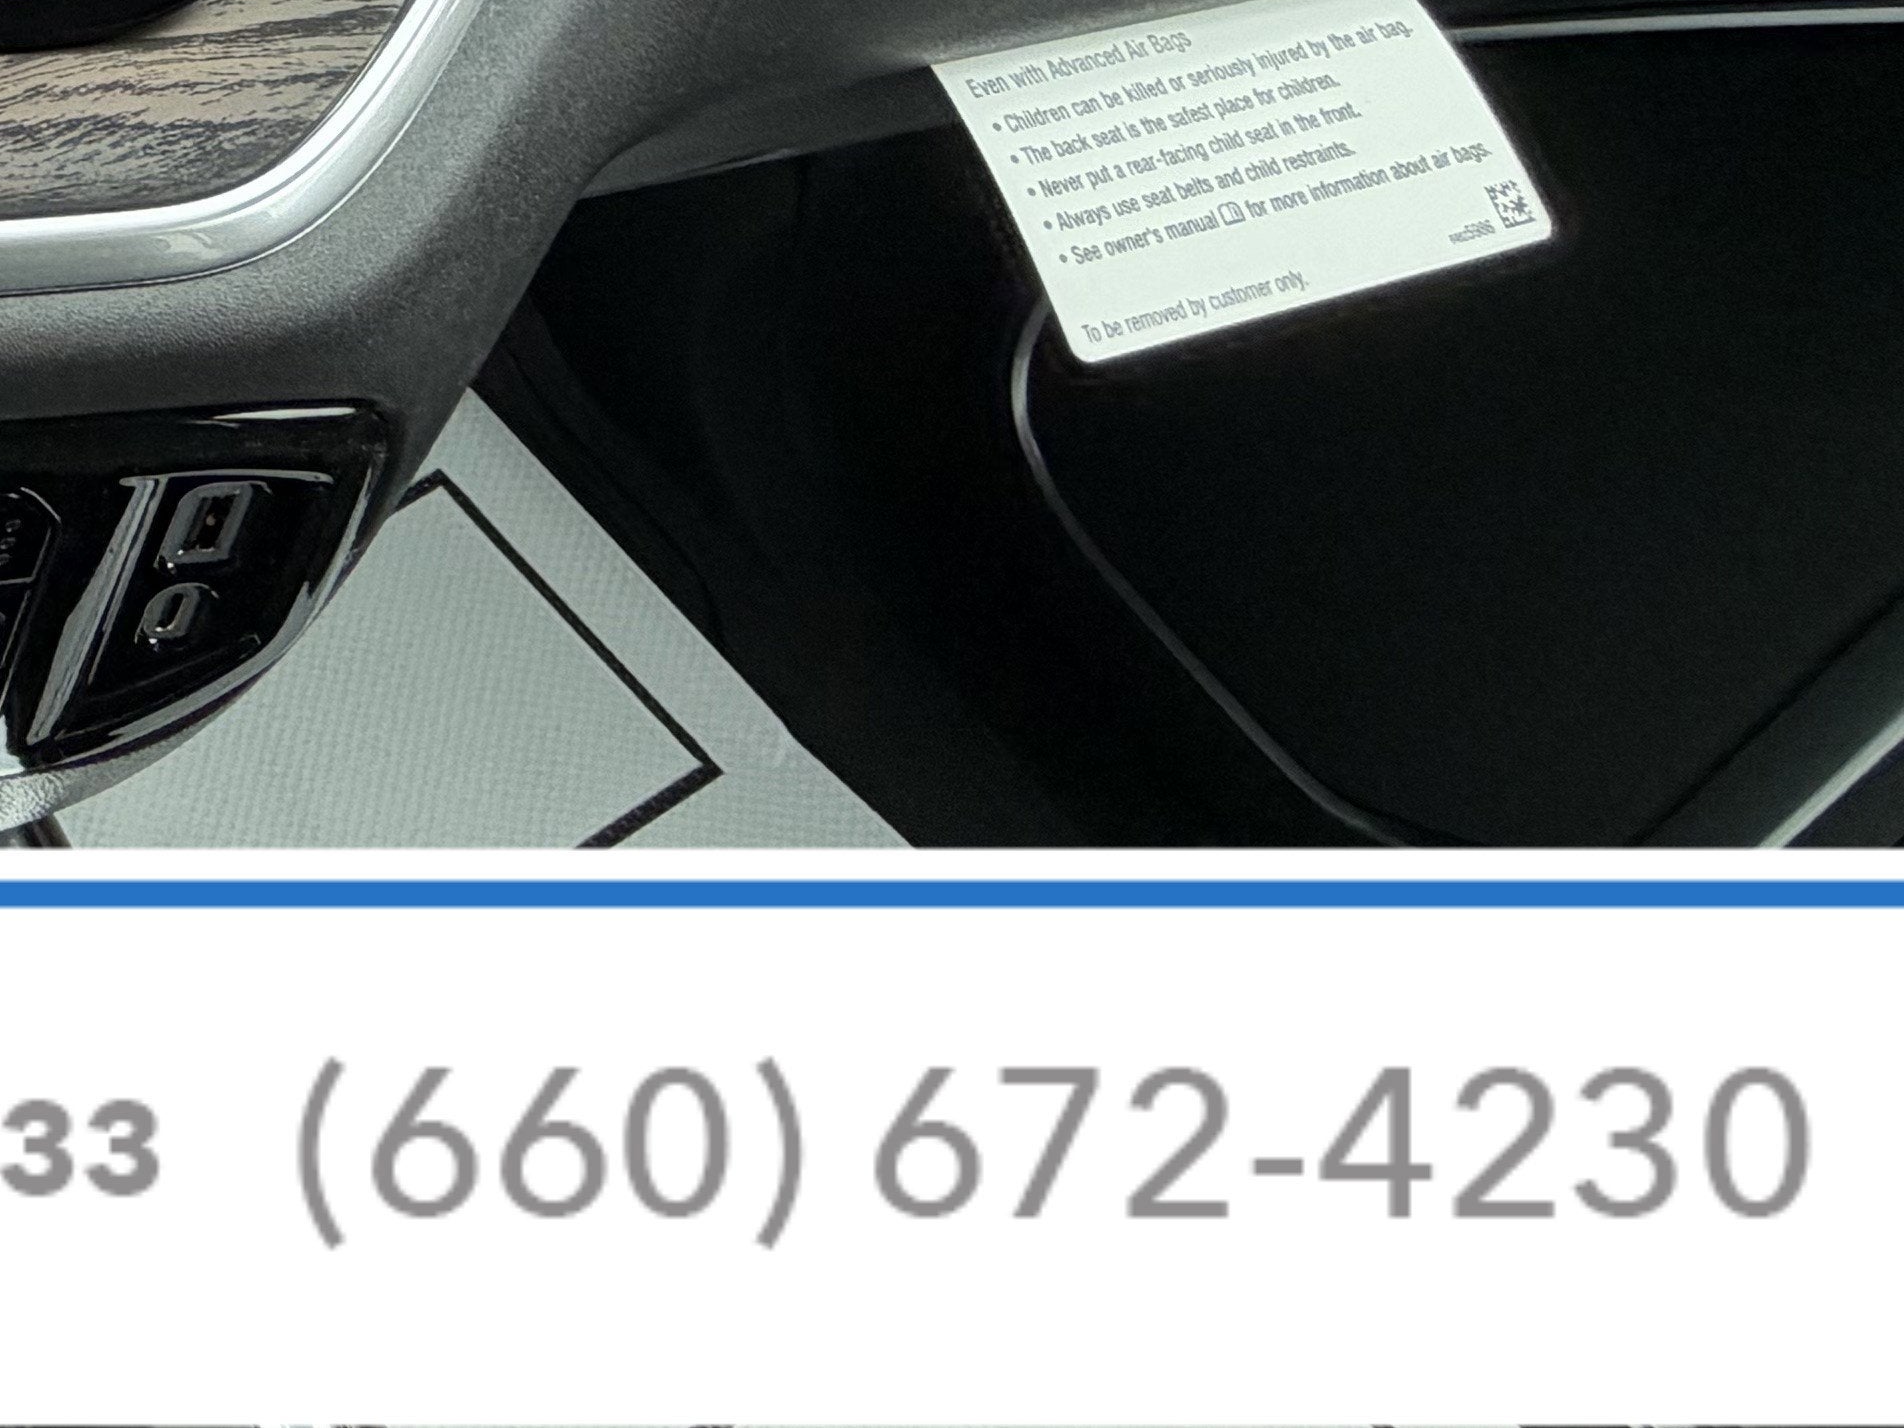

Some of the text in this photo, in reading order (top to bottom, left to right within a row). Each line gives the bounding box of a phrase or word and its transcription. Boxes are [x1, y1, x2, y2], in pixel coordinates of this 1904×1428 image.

[965, 32, 1192, 98] Even with Advanced Air Bags
[1004, 20, 1413, 133] Children can be killed or seriously injured by the air bag.
[1019, 73, 1341, 166] The back seat is the safest place for children.
[1038, 102, 1363, 197] Never put a rear-facing child seat in the front.
[1056, 205, 1111, 231] Always
[1112, 197, 1141, 217] use
[1142, 185, 1177, 208] seat
[1173, 177, 1214, 200] belts
[1215, 167, 1245, 189] and
[1245, 157, 1282, 182] child
[1071, 142, 1492, 265] See owner's manual for more information about air bags.
[1081, 269, 1309, 343] To be removed by customer only.
